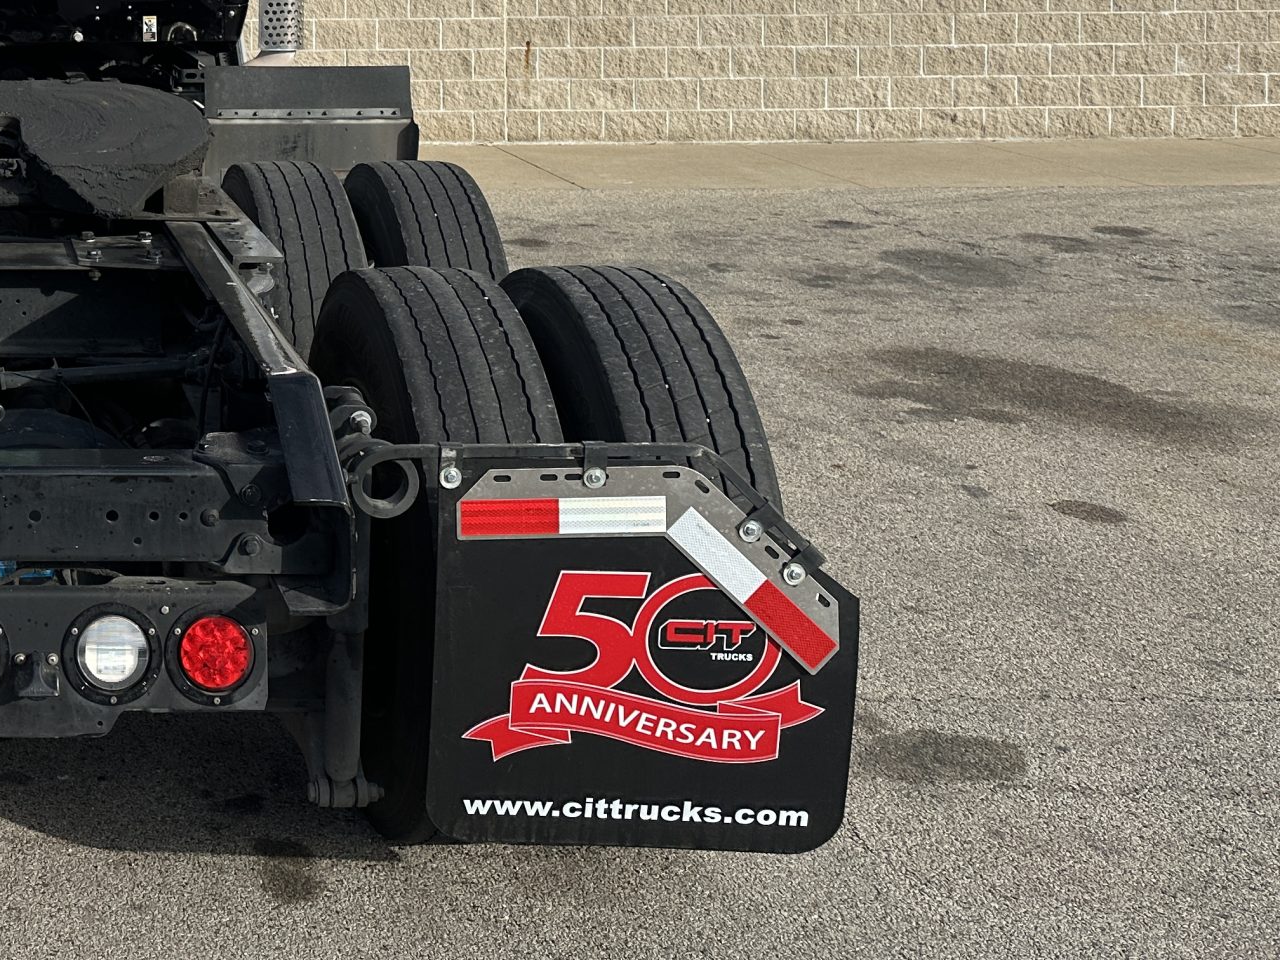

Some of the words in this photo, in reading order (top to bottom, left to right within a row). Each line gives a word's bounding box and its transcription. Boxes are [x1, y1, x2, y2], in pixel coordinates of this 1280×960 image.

[663, 620, 756, 647] CIT
[710, 652, 753, 662] TRUCKS
[528, 693, 766, 750] ANNIVERSARY
[463, 798, 809, 827] www.cittrucks.com
